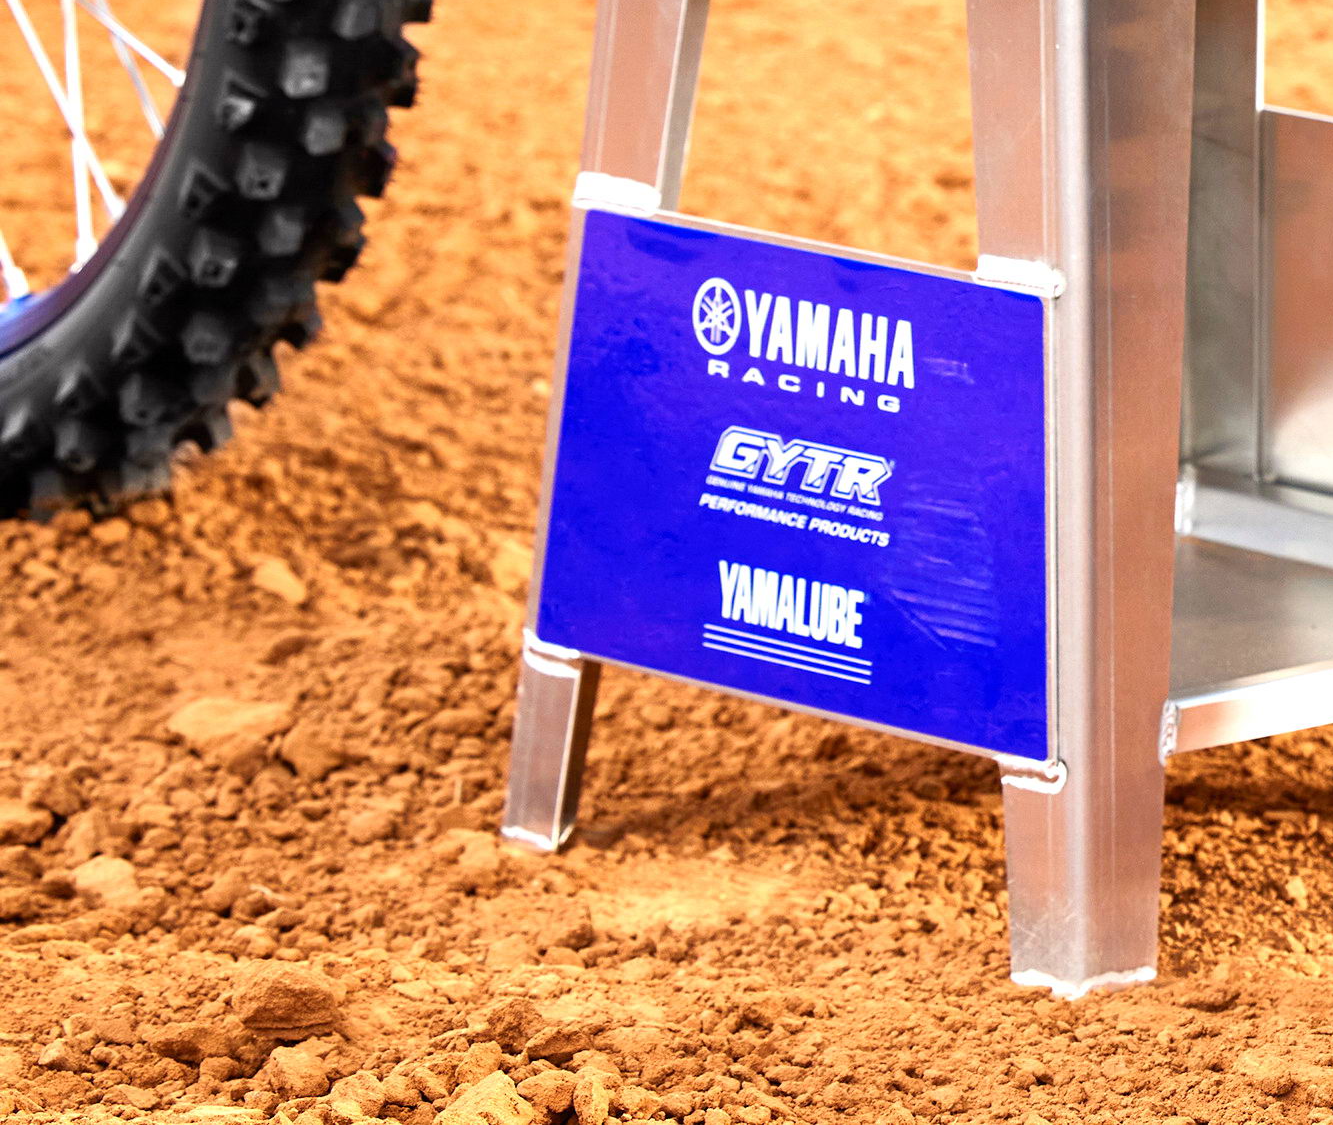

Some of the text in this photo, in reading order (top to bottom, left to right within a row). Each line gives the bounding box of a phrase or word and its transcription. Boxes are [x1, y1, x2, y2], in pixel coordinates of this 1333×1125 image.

[744, 289, 915, 389] YAMAHA
[707, 359, 901, 413] RACING
[705, 474, 885, 522] GENUINE YAMAHA TECHNOLOGY RACING
[710, 425, 893, 506] GYTR
[699, 493, 891, 548] PERFORMANCE PRODUCTS
[718, 560, 866, 649] YAMALUBE
